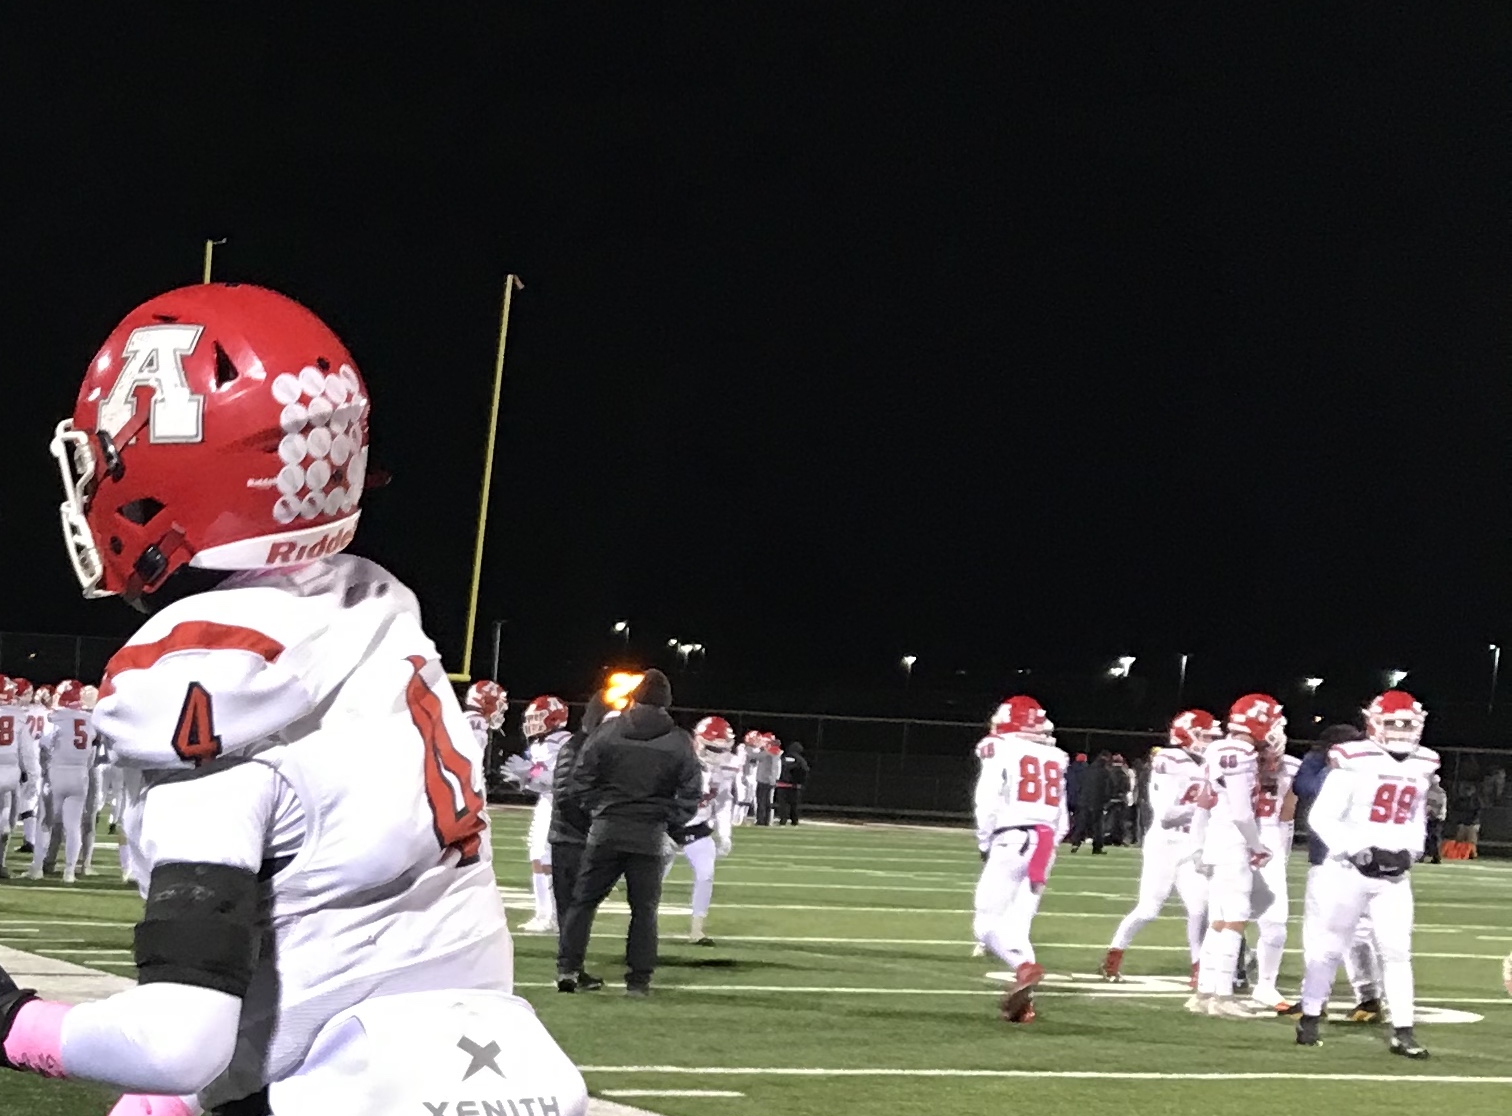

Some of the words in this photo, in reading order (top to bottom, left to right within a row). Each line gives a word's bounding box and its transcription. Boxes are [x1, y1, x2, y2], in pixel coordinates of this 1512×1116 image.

[96, 324, 205, 445] A
[73, 718, 88, 750] 5
[171, 681, 223, 767] 4
[1017, 754, 1062, 808] 88
